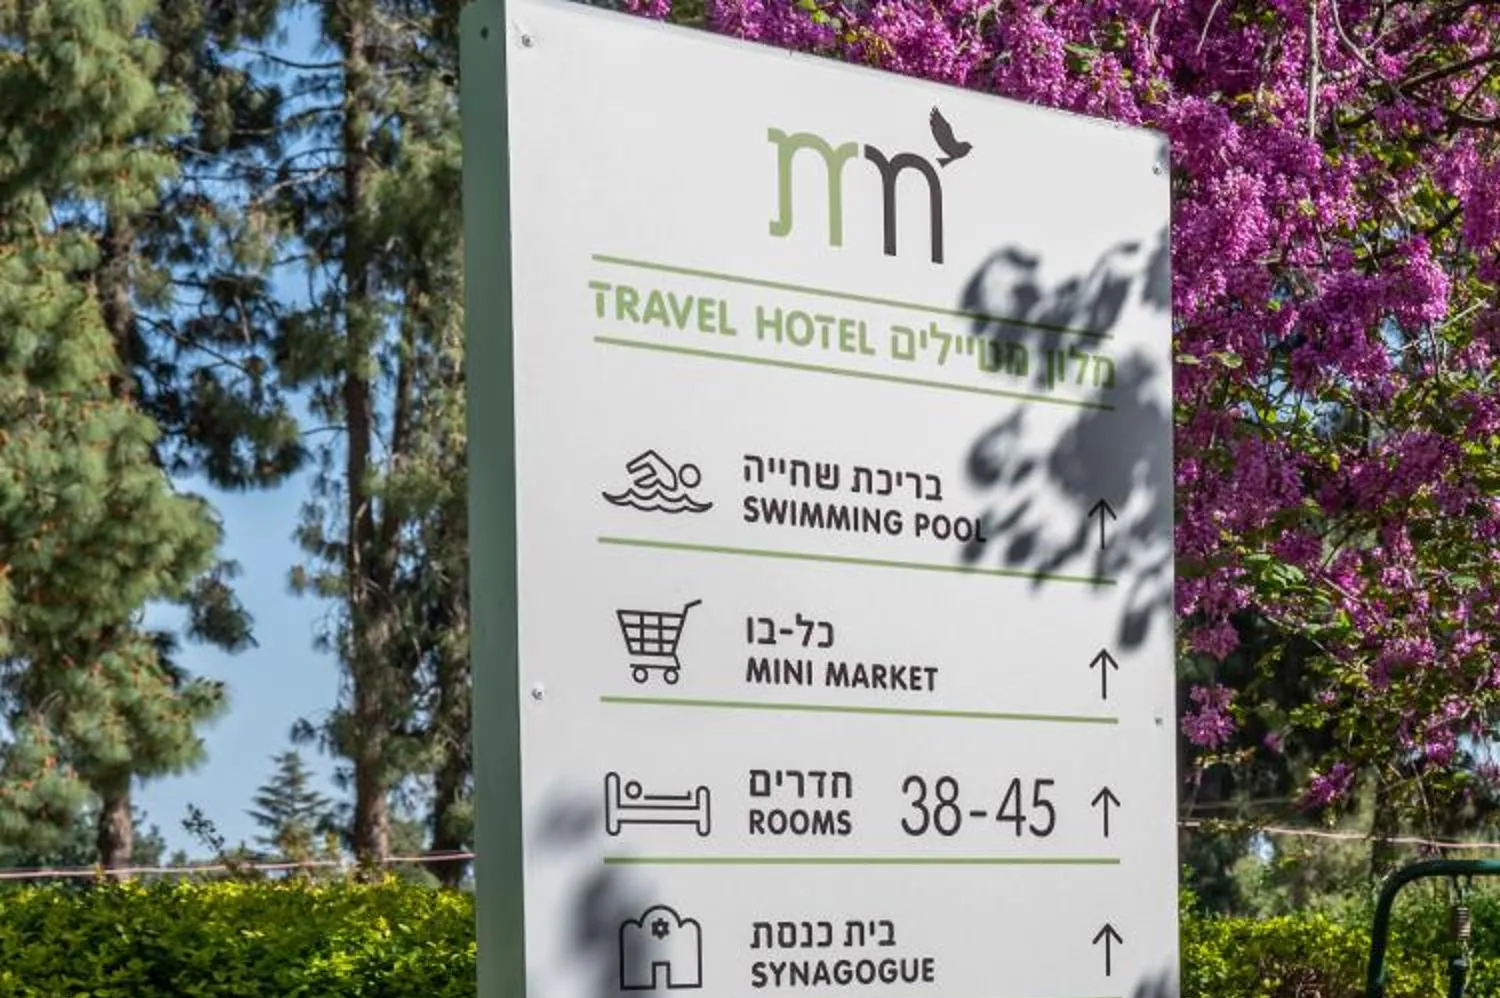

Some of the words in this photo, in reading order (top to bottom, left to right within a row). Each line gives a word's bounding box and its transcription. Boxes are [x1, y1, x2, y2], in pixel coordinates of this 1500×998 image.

[588, 280, 737, 336] TRAVEL
[755, 305, 876, 356] HOTEL
[890, 321, 1028, 376] מטיילים
[1046, 343, 1116, 391] מלון
[743, 454, 840, 490] שחייה
[850, 466, 943, 501] בריכת
[743, 495, 903, 535] SWIMMING
[914, 512, 987, 543] POOL
[746, 612, 835, 648] כל-בו
[745, 656, 813, 686] MINI
[825, 661, 939, 692] MARKET
[749, 769, 853, 799] חדרים
[748, 808, 852, 835] ROOMS
[900, 775, 1057, 837] 38-45
[750, 920, 834, 949] כנסת
[843, 919, 897, 947] בית
[751, 957, 935, 988] SYNAGOGUE
